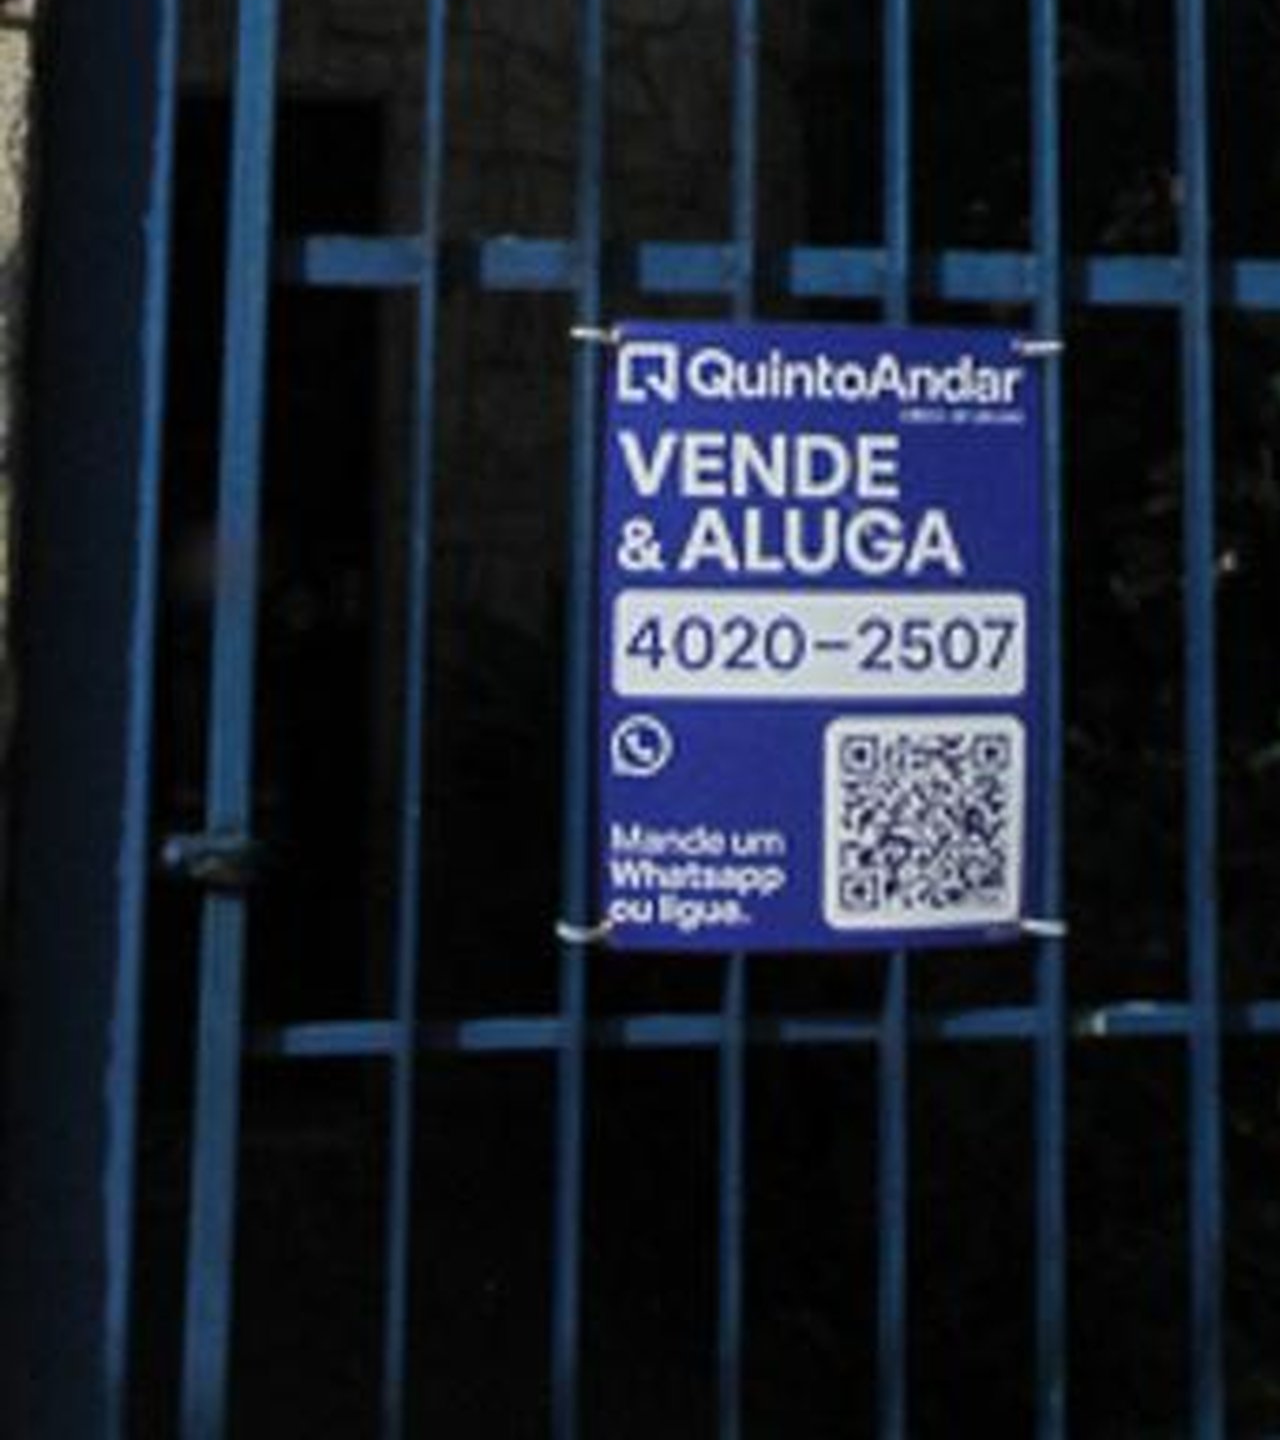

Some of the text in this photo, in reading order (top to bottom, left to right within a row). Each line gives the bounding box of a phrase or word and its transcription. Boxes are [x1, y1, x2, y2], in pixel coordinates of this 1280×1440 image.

[687, 346, 1024, 403] QuintoAndar
[618, 432, 899, 498] VENDE
[618, 507, 963, 574] & ALUGA
[625, 614, 1018, 673] 4020-2507
[611, 822, 786, 857] Mande um
[610, 860, 787, 898] Whatsapp
[610, 899, 653, 924] ou
